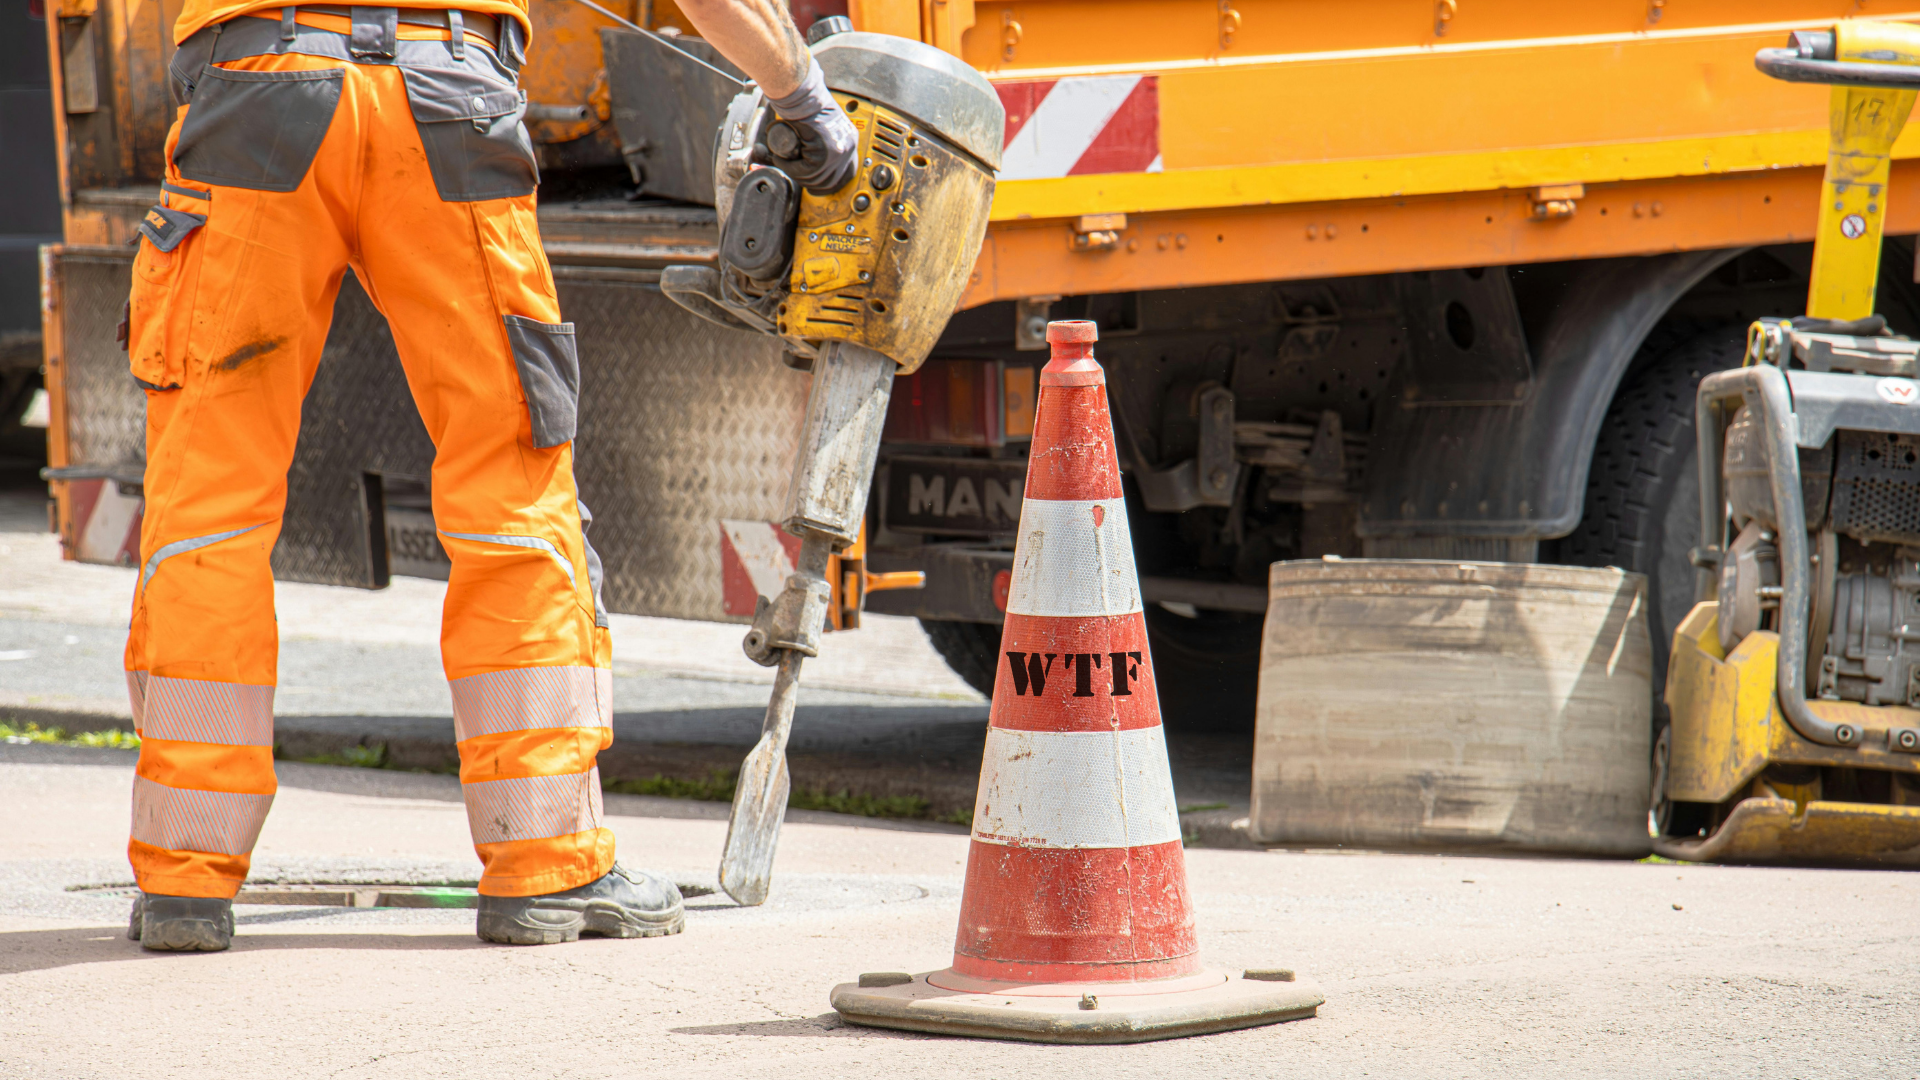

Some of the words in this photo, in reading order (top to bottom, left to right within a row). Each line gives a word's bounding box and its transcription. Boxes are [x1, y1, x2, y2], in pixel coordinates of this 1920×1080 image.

[1852, 97, 1884, 125] 17
[909, 474, 1025, 523] MAN
[1006, 651, 1142, 697] WTF
